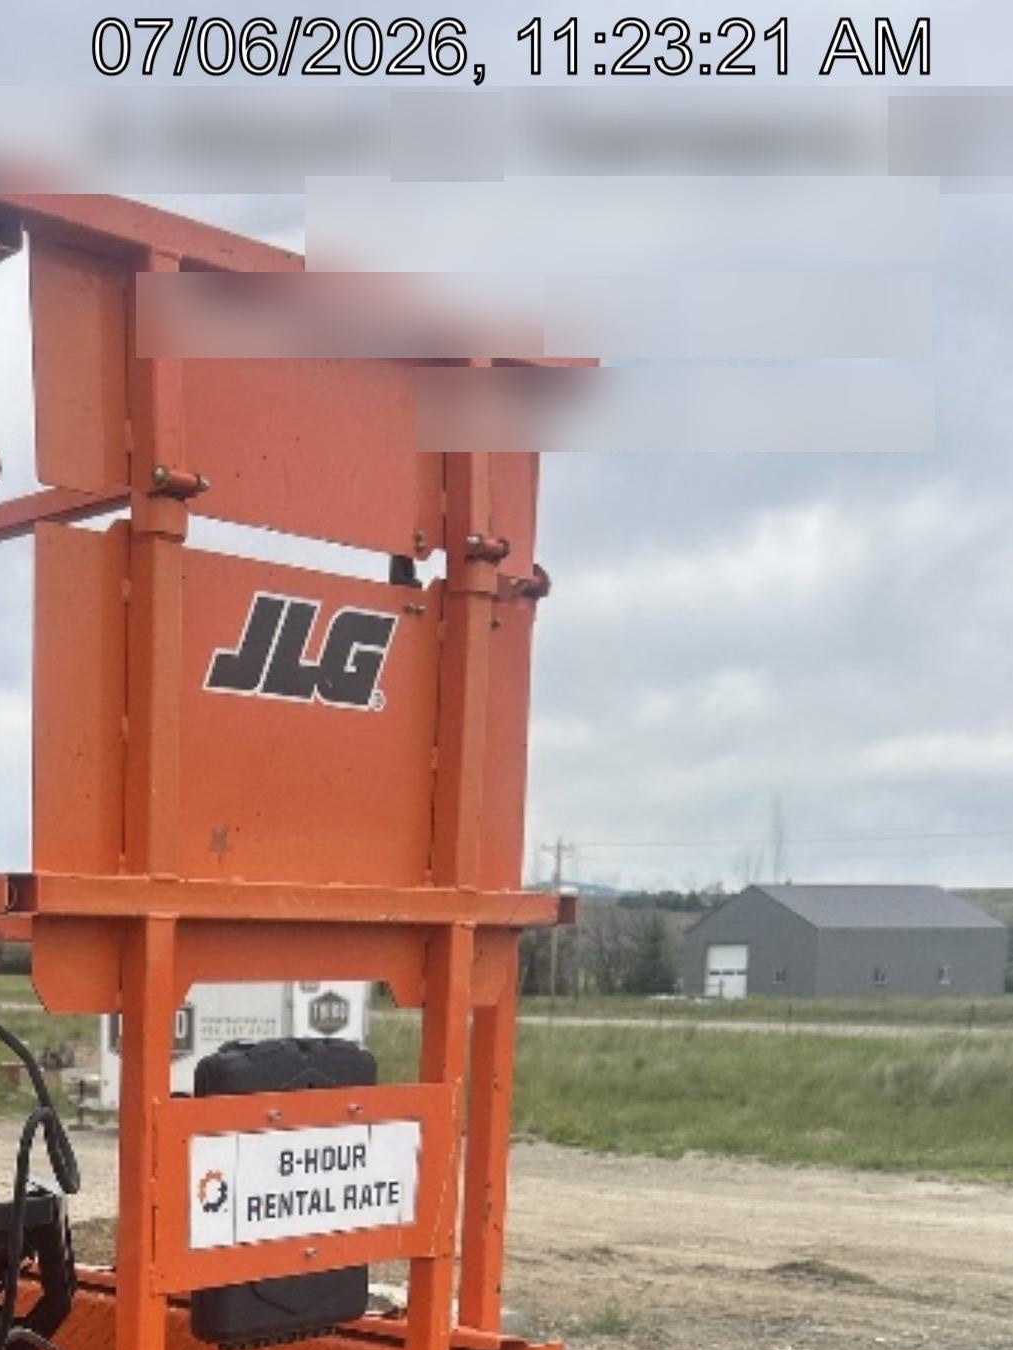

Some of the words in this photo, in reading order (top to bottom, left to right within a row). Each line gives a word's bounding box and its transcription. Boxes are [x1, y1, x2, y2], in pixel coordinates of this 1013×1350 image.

[202, 591, 399, 711] JLG
[279, 1144, 368, 1177] 8-HOUR
[246, 1187, 337, 1222] RENTAL
[343, 1180, 401, 1211] RATE
